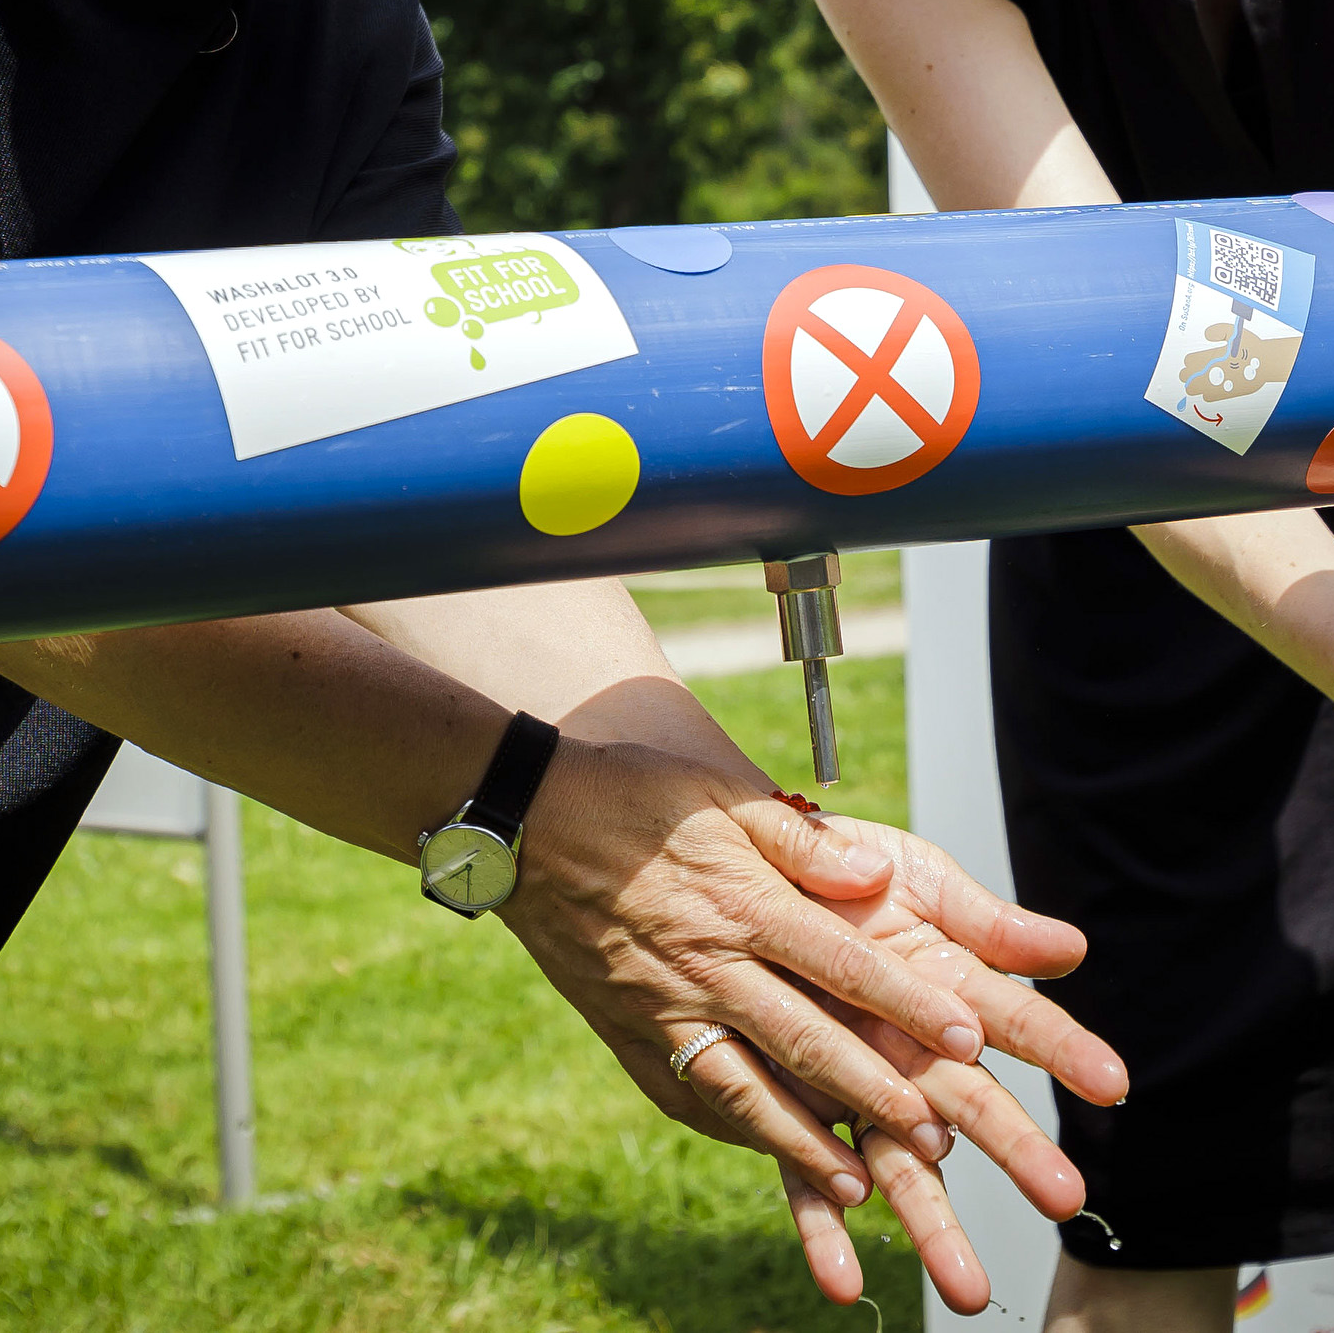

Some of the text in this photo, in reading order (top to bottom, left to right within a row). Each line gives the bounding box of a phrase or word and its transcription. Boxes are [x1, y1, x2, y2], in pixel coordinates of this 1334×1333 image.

[206, 267, 358, 305] WASHaLOT 3.0
[447, 256, 548, 289] FIT FOR
[223, 284, 382, 332] DEVELOPED BY
[463, 274, 567, 313] SCHOOL
[236, 307, 413, 363] FIT FOR SCHOOL
